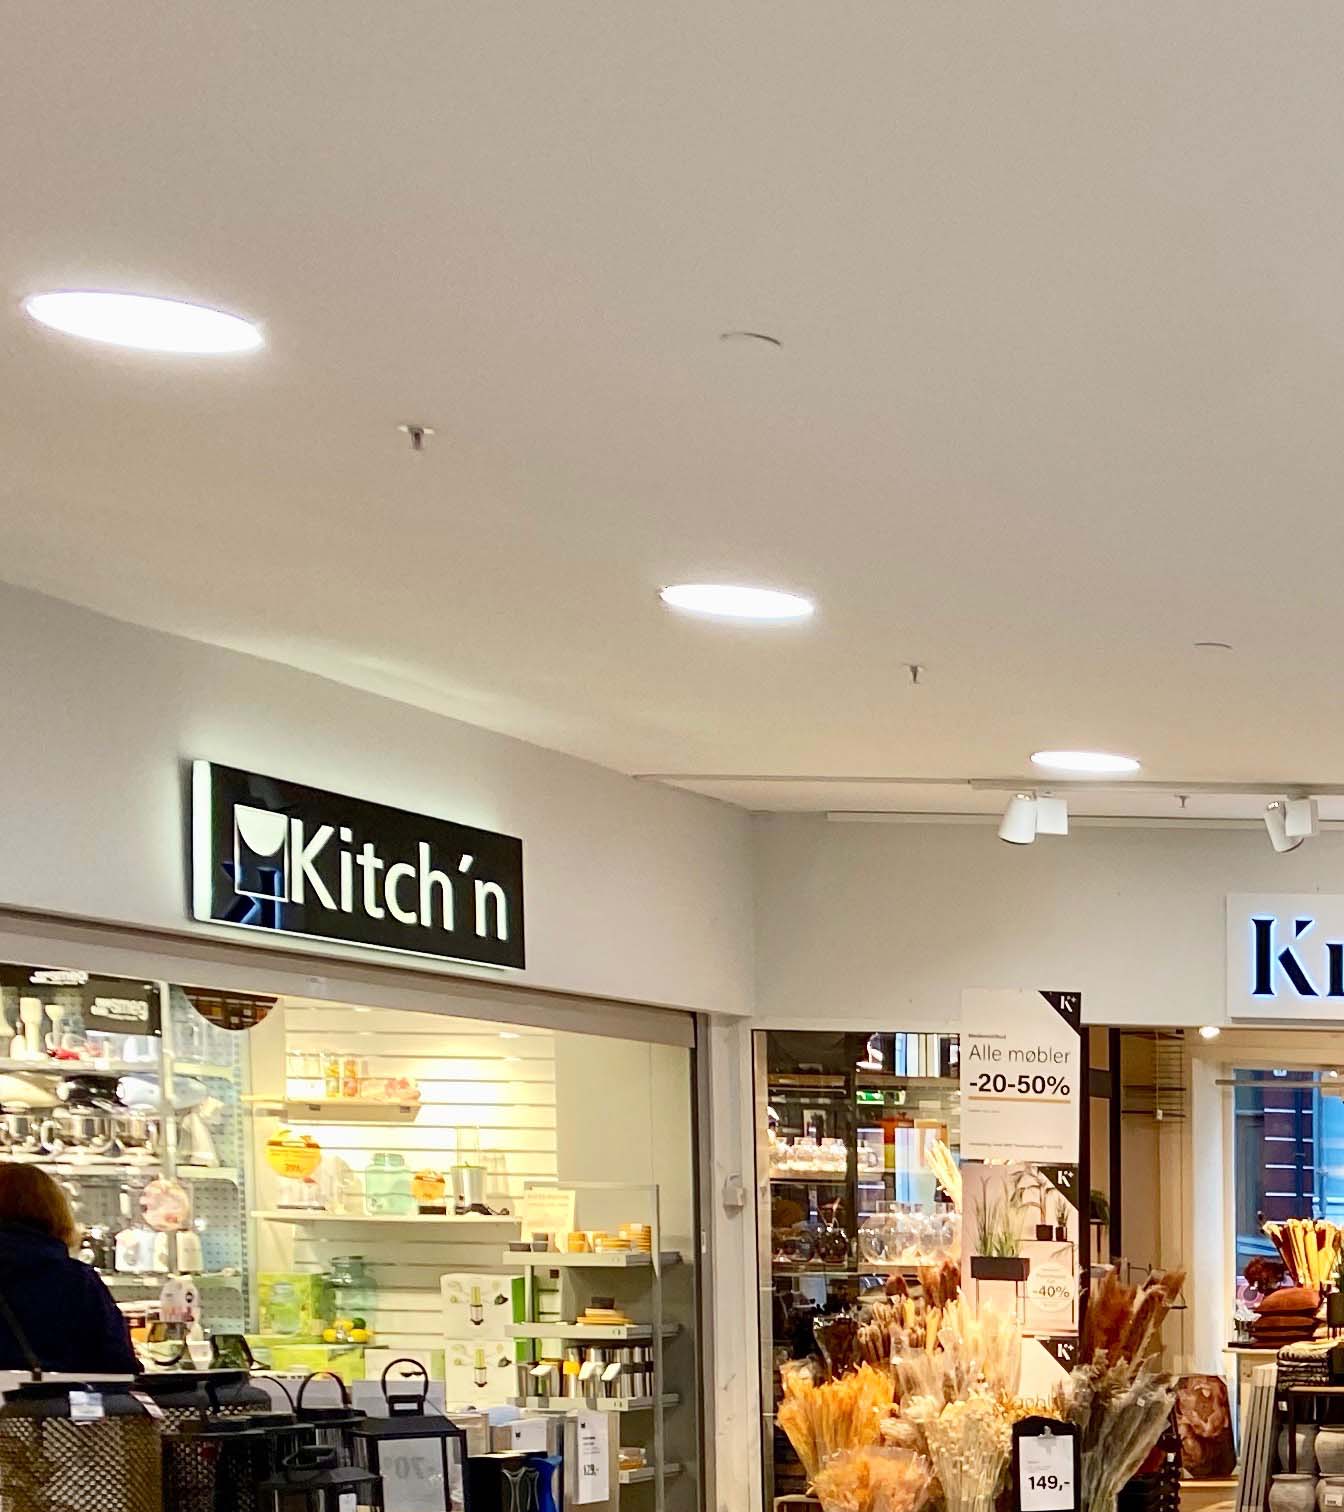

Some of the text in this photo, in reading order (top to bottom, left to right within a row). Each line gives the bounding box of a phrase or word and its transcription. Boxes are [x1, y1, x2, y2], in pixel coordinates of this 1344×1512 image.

[969, 1044, 1071, 1064] Alle møbler
[969, 1073, 1071, 1096] -20-50%
[1032, 1286, 1071, 1298] -40%
[1028, 1475, 1070, 1491] 149,-
